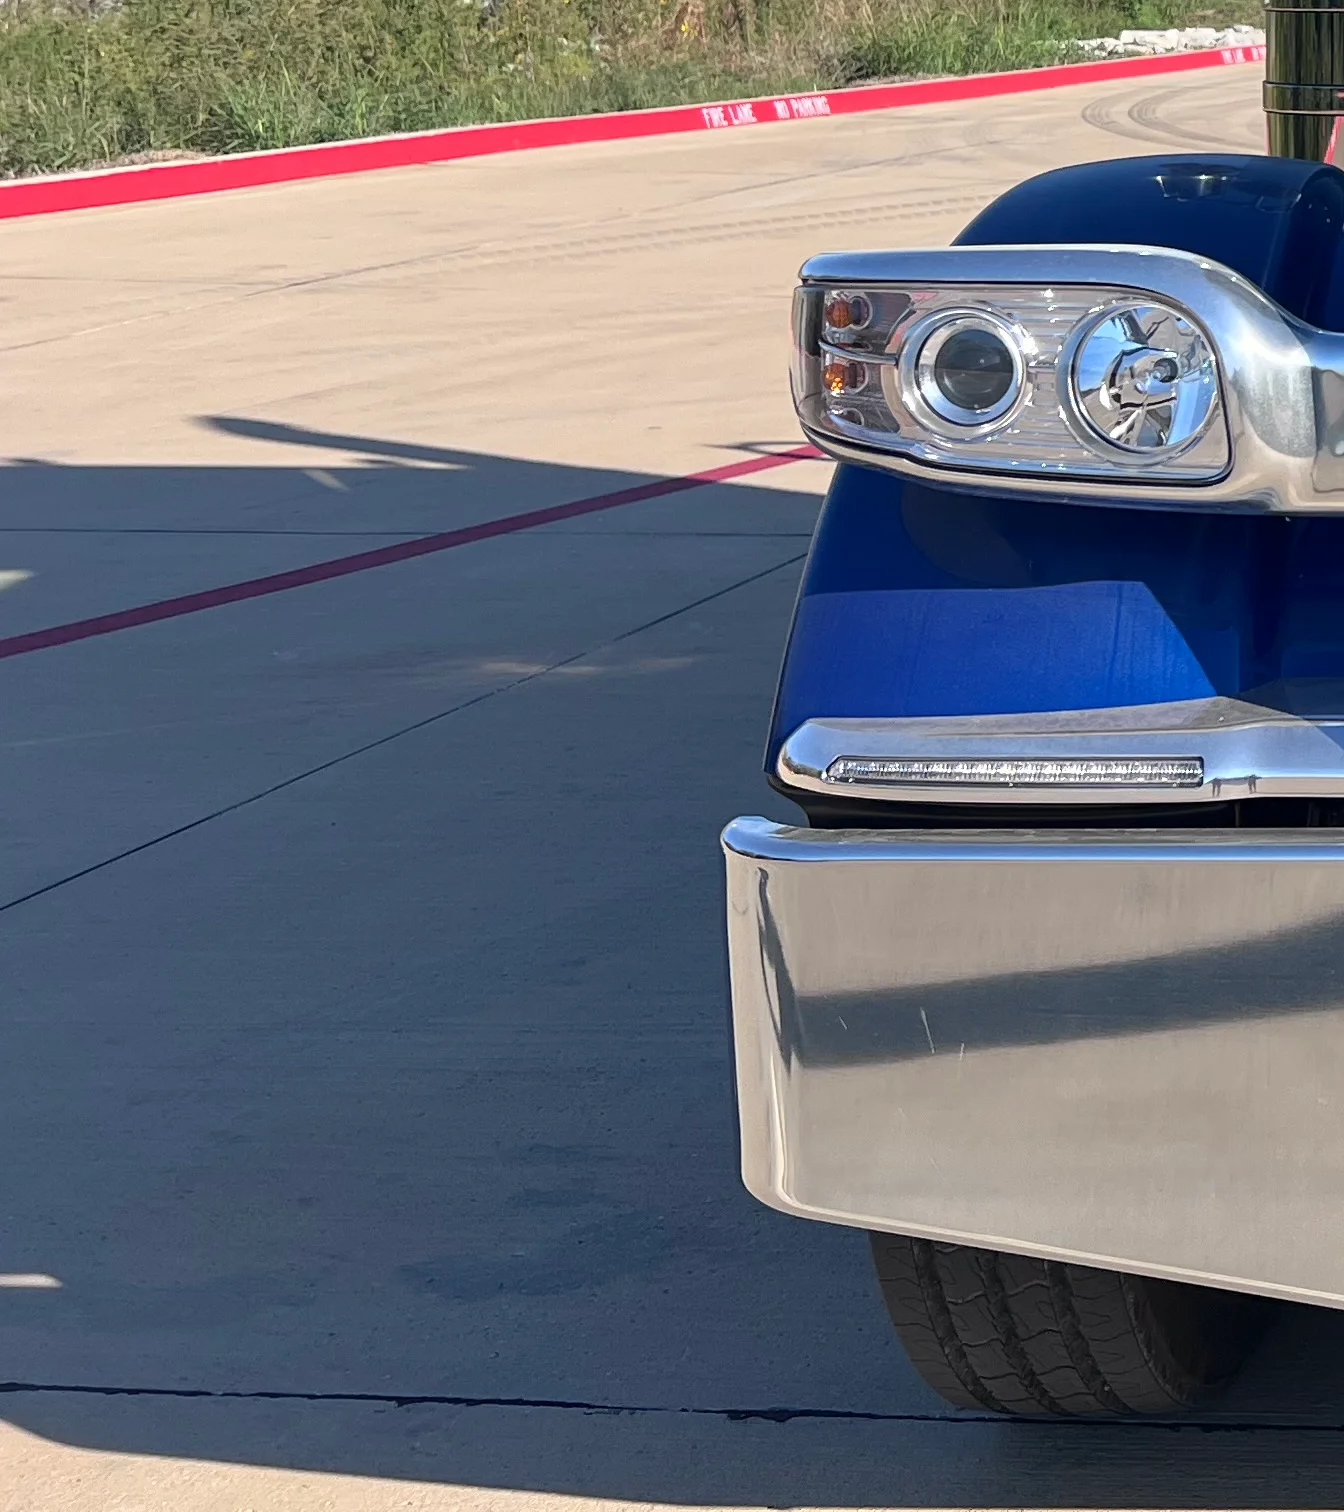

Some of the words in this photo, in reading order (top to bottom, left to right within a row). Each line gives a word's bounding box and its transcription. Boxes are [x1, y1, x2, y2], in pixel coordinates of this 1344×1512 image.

[701, 106, 729, 129] FIRE
[727, 103, 758, 126] LANE
[773, 99, 790, 120] NO
[789, 95, 831, 119] PARKING
